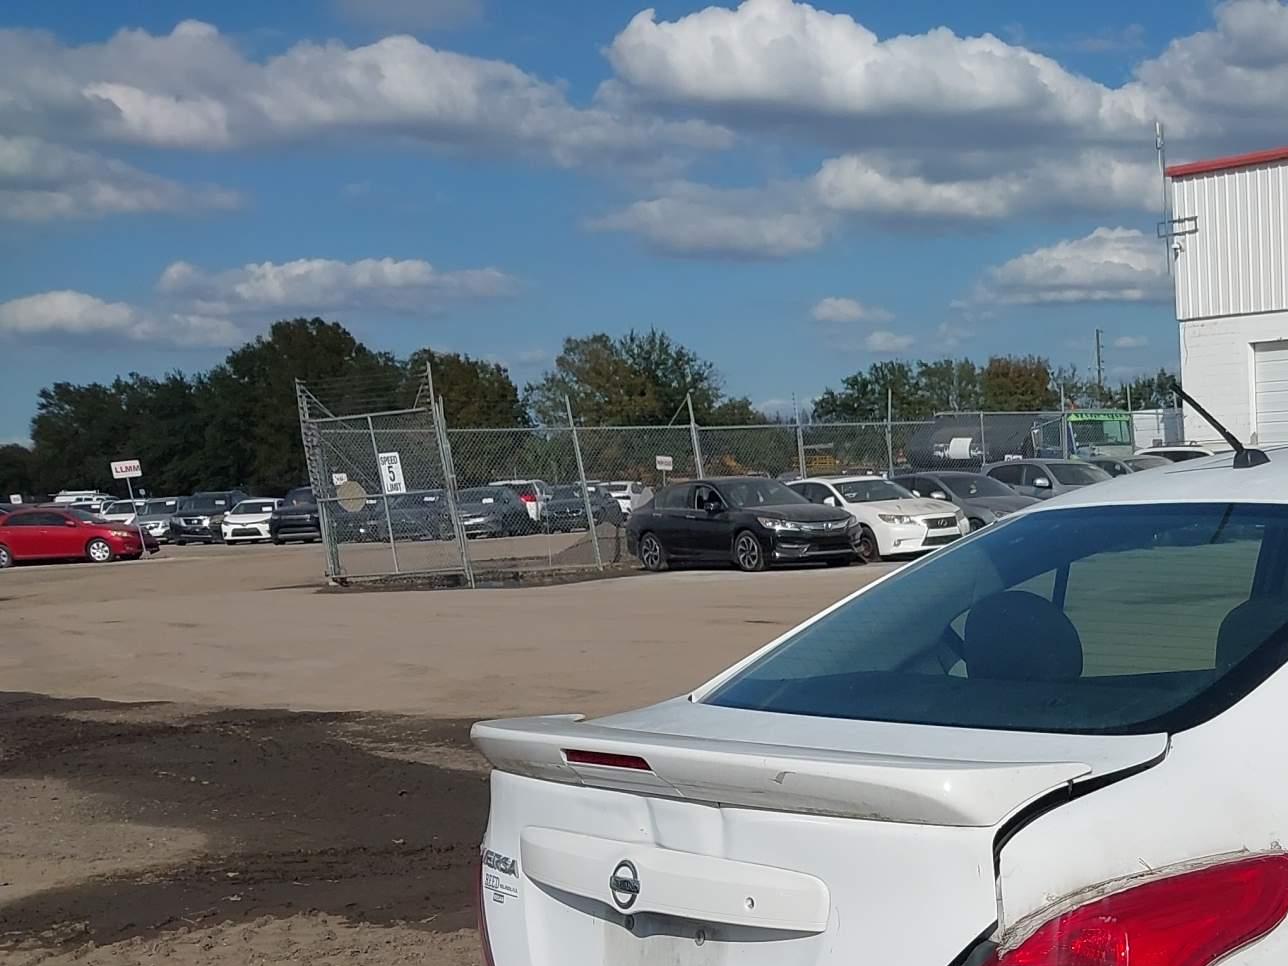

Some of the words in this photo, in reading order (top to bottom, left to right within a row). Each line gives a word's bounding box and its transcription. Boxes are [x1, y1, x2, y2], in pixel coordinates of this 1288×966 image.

[380, 455, 398, 465] SPEED
[387, 465, 396, 482] 5
[386, 483, 402, 493] LIMIT
